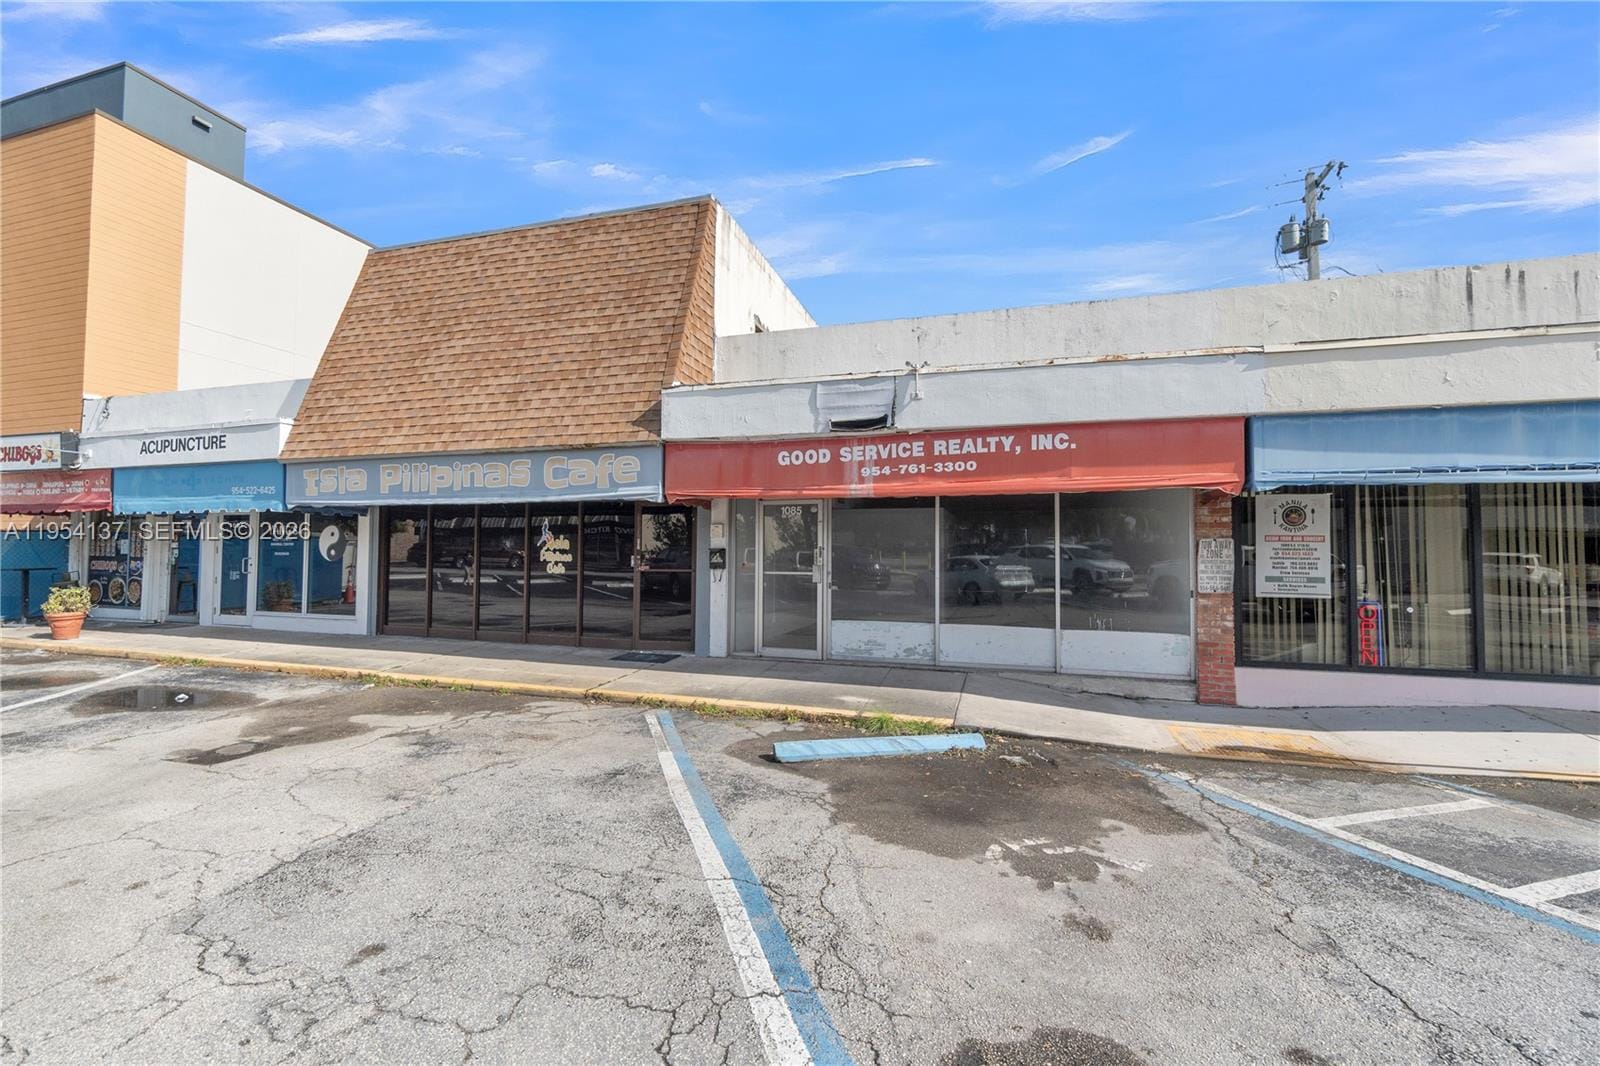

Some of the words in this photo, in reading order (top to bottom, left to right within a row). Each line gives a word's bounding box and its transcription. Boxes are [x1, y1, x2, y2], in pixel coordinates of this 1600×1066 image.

[139, 434, 227, 455] ACUPUNCTURE
[777, 448, 832, 466] GOOD
[839, 441, 925, 462] SERVICE
[933, 435, 1021, 455] REALTY,
[1031, 432, 1077, 451] INC.
[303, 465, 368, 497] Isla
[379, 459, 532, 495] Pilipinas
[543, 453, 641, 489] Cafe
[860, 460, 978, 477] 954-761-3300
[781, 506, 803, 516] 1085
[1278, 499, 1309, 510] MANILA
[1278, 523, 1309, 533] KANTINA
[1206, 549, 1223, 559] ZONE
[1357, 604, 1378, 666] OPEN
